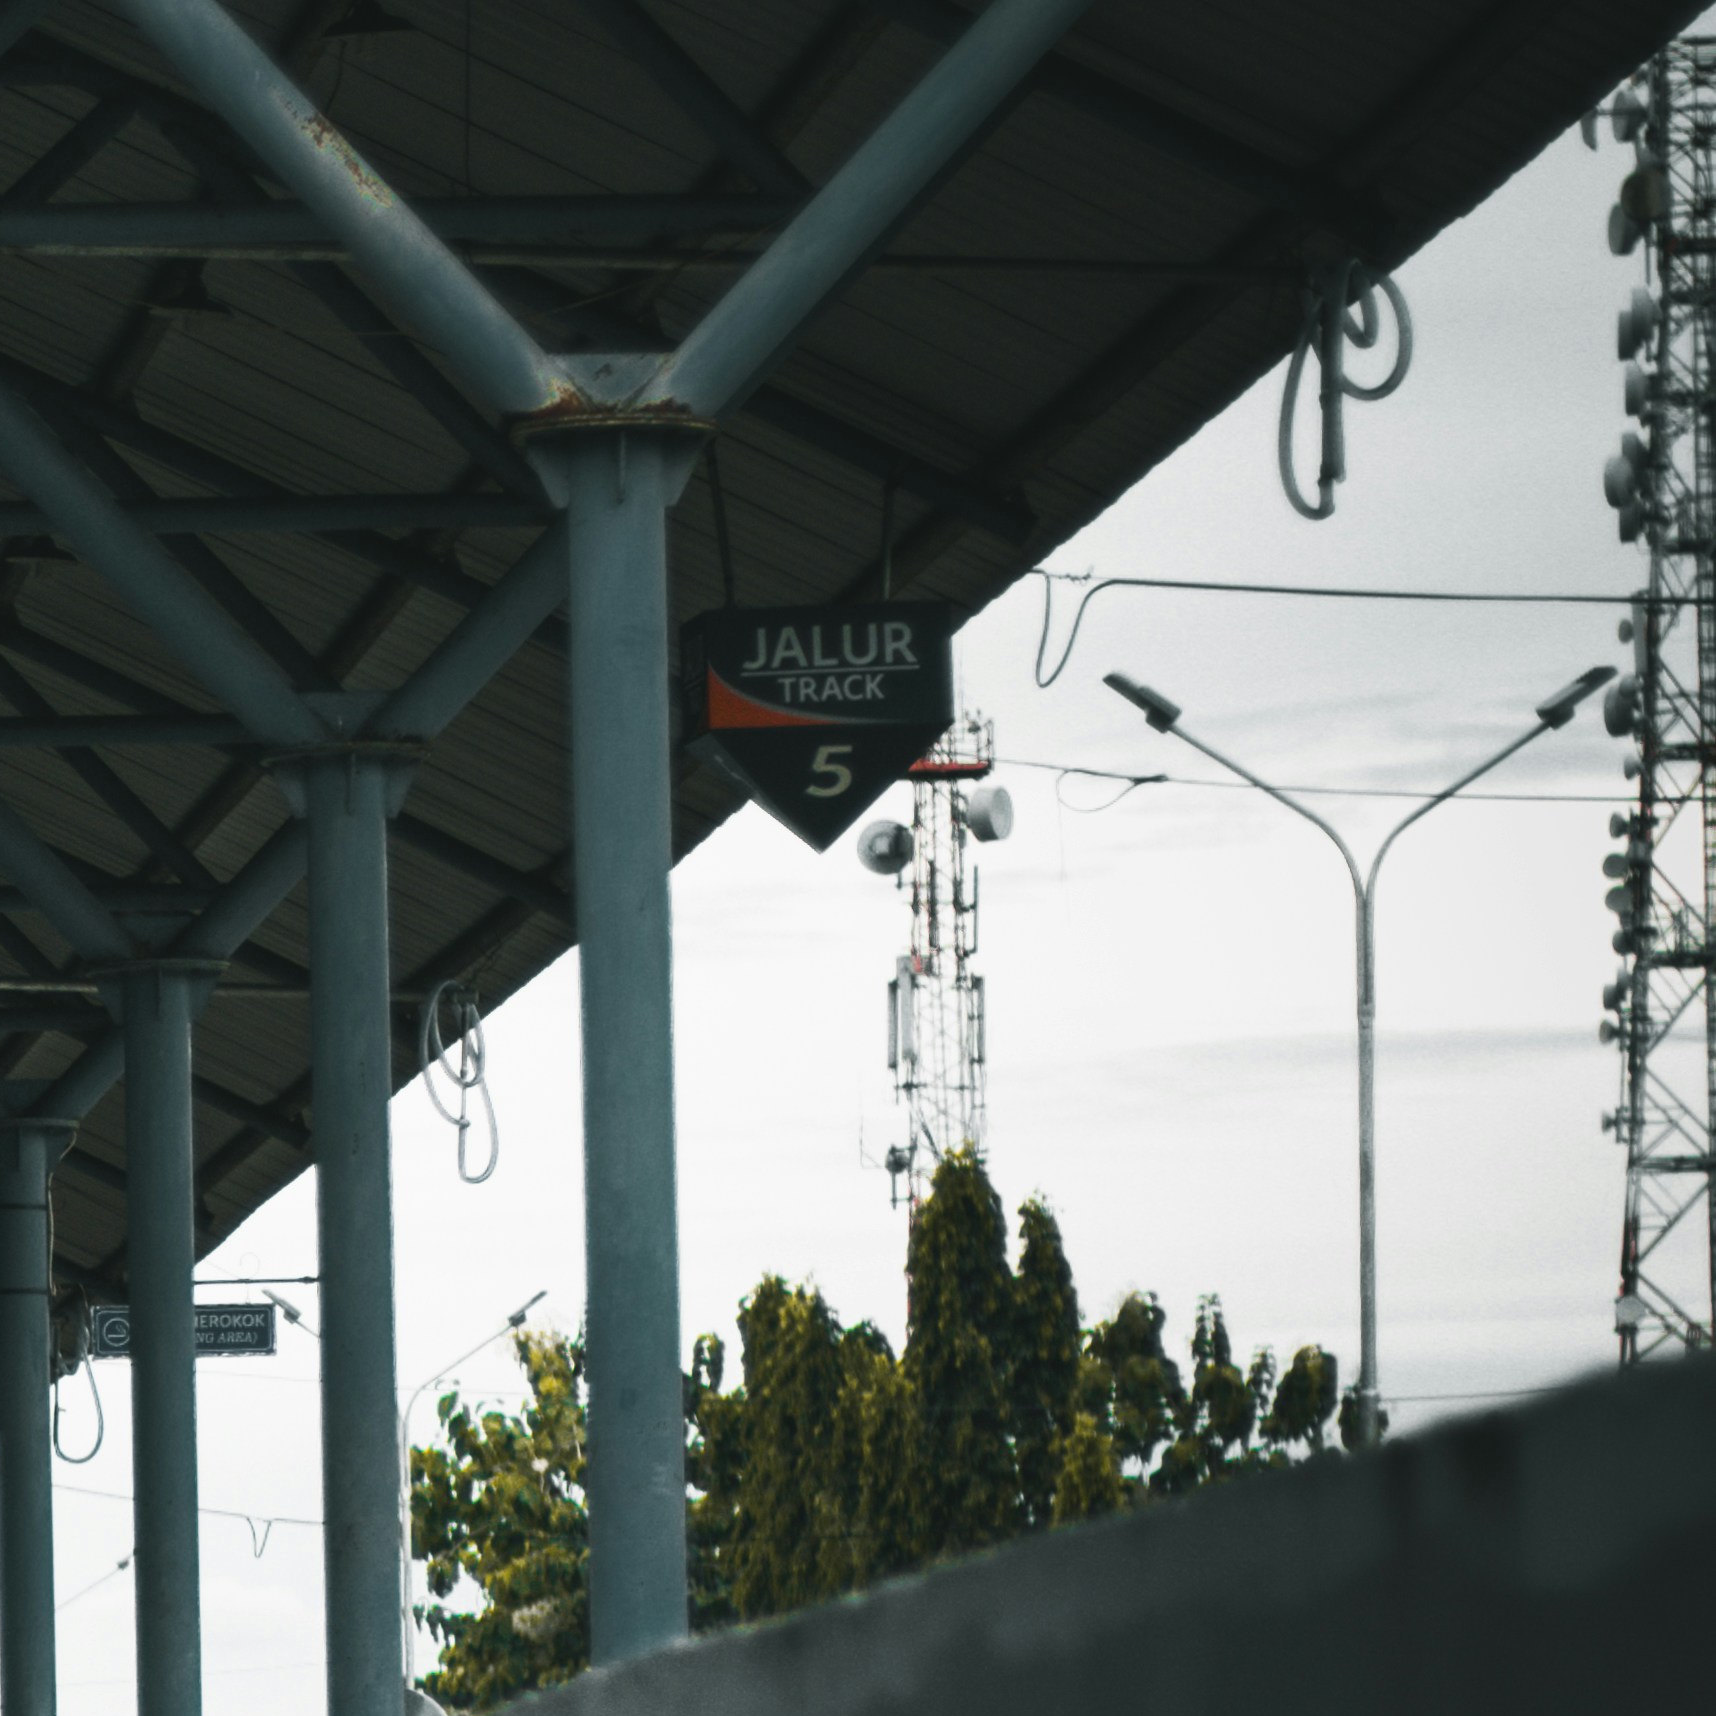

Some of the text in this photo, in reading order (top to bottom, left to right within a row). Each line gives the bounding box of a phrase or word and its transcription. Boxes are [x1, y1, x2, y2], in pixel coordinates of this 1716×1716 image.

[742, 621, 918, 670] JALUR
[777, 673, 885, 704] TRACK
[805, 745, 853, 798] 5
[194, 1314, 265, 1328] EROKOK
